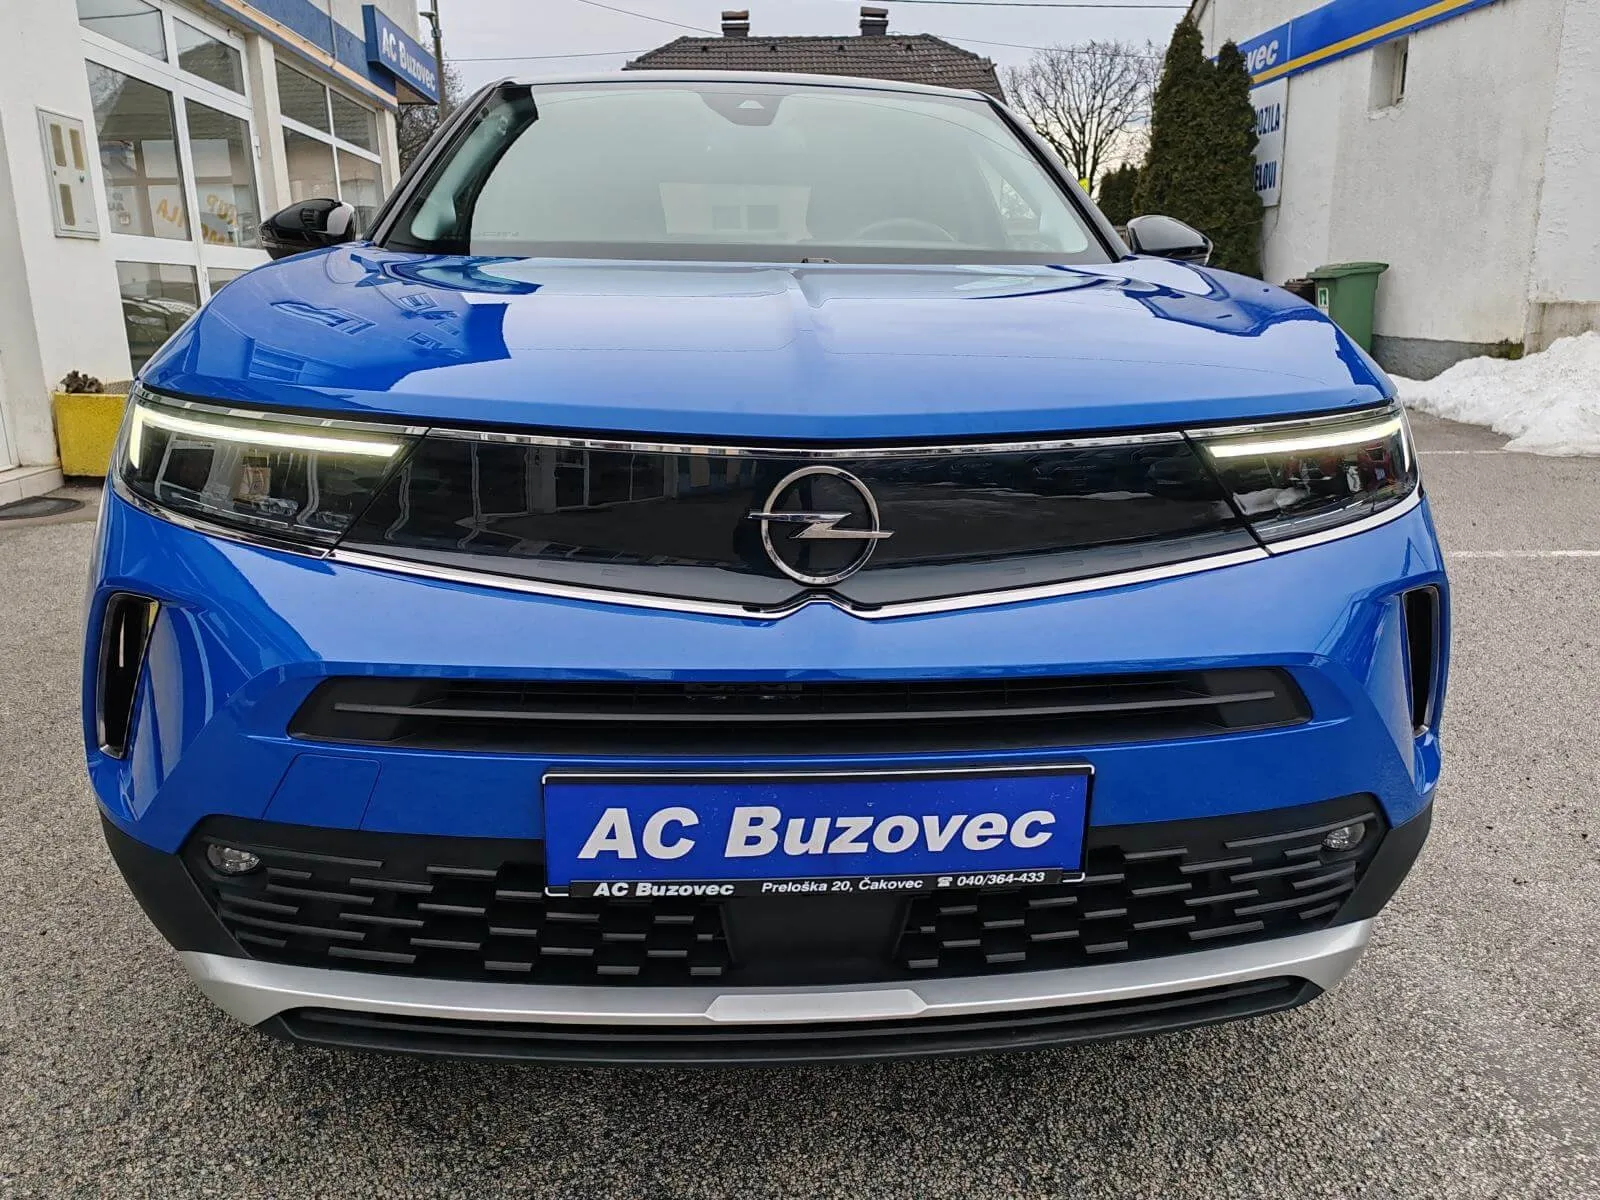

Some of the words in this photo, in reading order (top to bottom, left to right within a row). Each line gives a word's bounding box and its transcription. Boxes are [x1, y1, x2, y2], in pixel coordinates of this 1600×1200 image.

[382, 27, 397, 63] AC
[398, 39, 436, 92] Buzovec
[1243, 40, 1279, 73] vec
[1253, 160, 1278, 192] ELOVI
[577, 806, 700, 860] AC
[724, 805, 1056, 858] Buzovec
[593, 882, 629, 897] AC
[635, 882, 735, 897] Buzovec
[761, 880, 828, 893] Preloška
[831, 880, 854, 893] 20,
[858, 876, 924, 891] Čakovec
[957, 871, 1046, 887] 040/364-433
